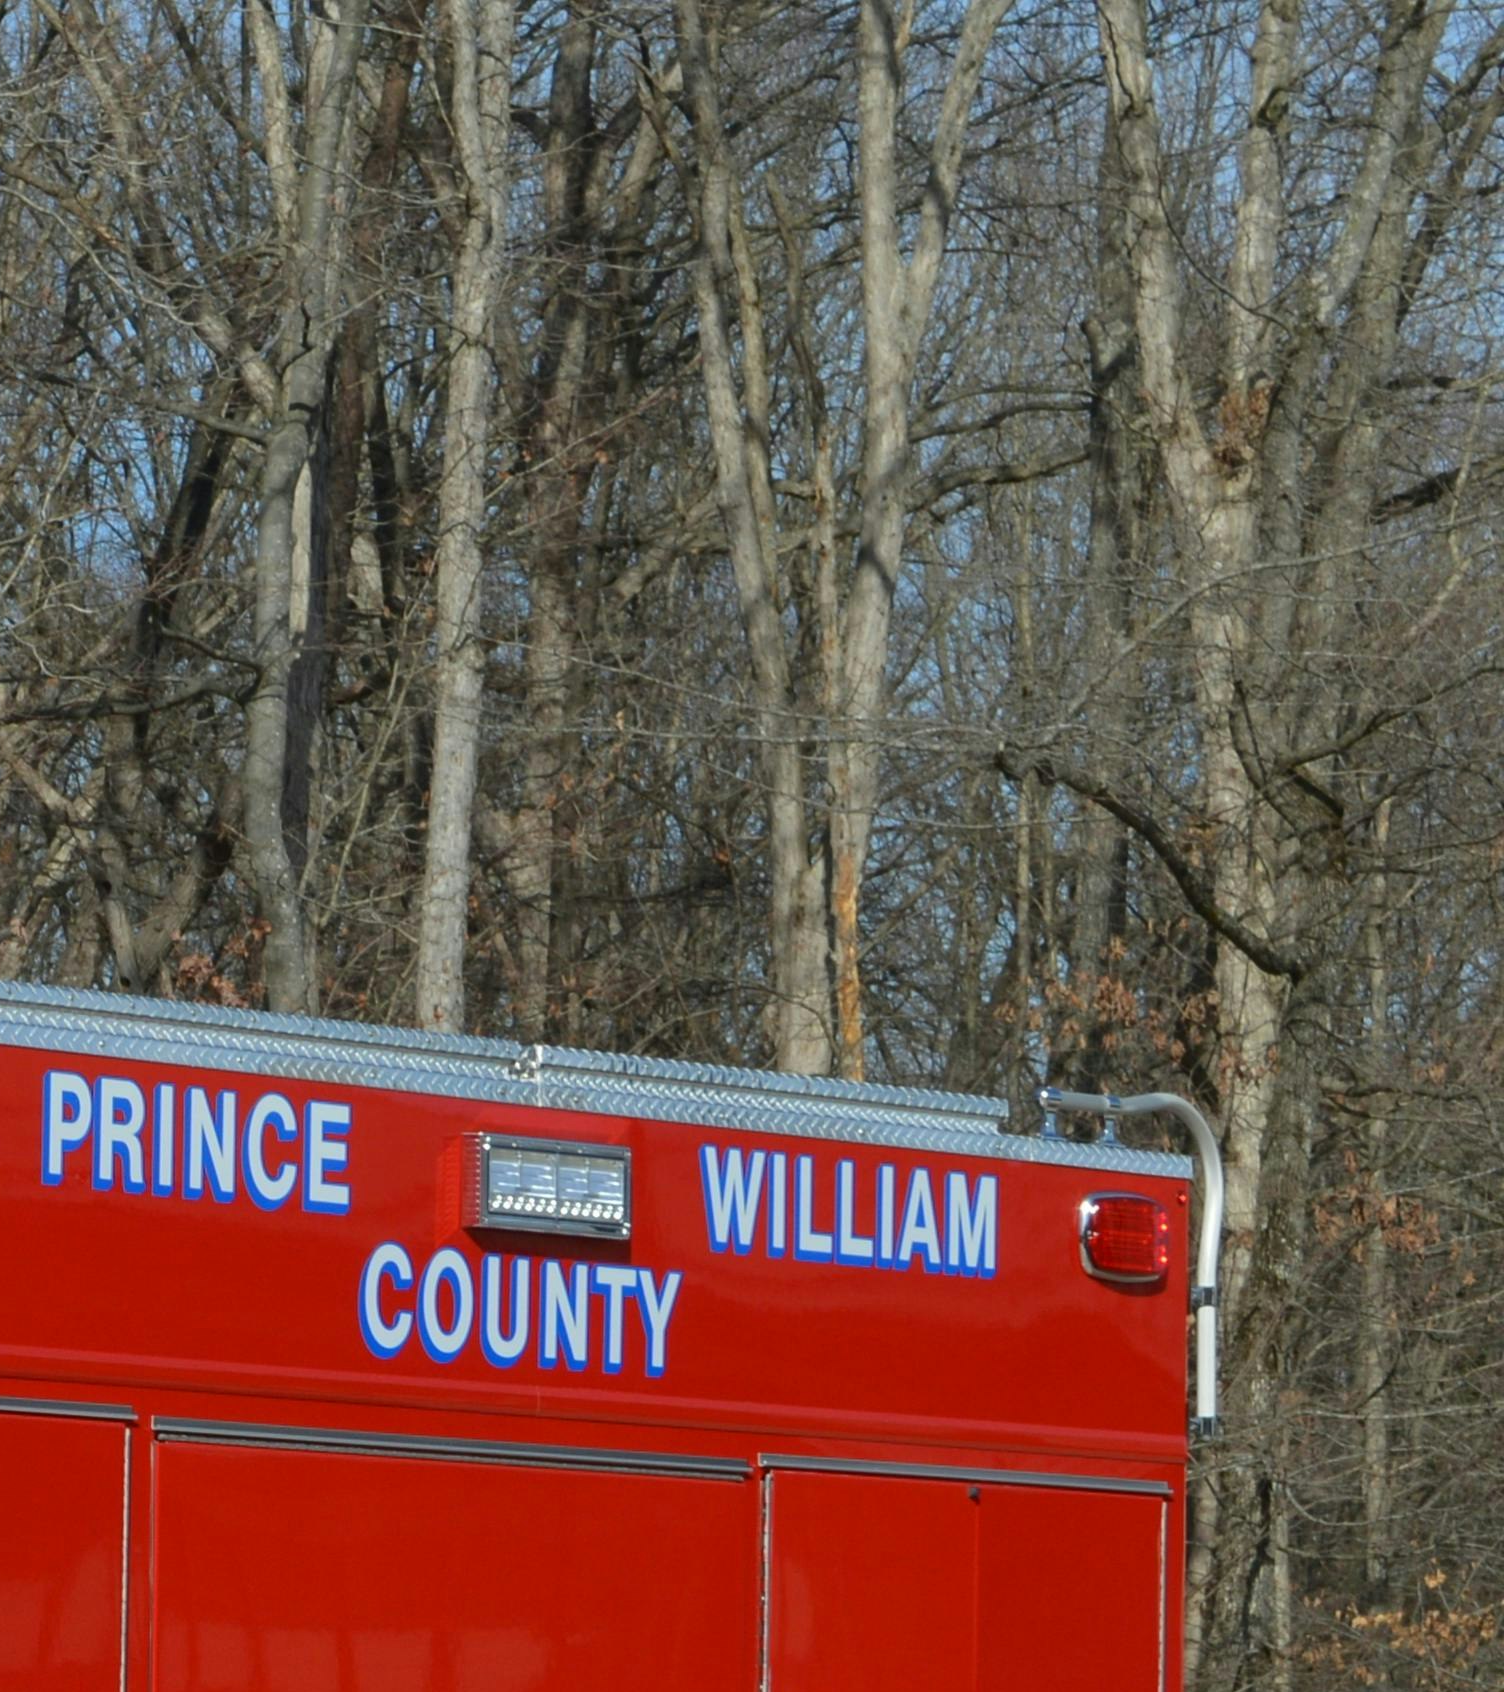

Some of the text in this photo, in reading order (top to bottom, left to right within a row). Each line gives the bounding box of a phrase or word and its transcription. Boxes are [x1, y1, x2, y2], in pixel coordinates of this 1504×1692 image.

[41, 1068, 999, 1280] PRINCE WILLIAM
[358, 1240, 683, 1378] COUNTY
